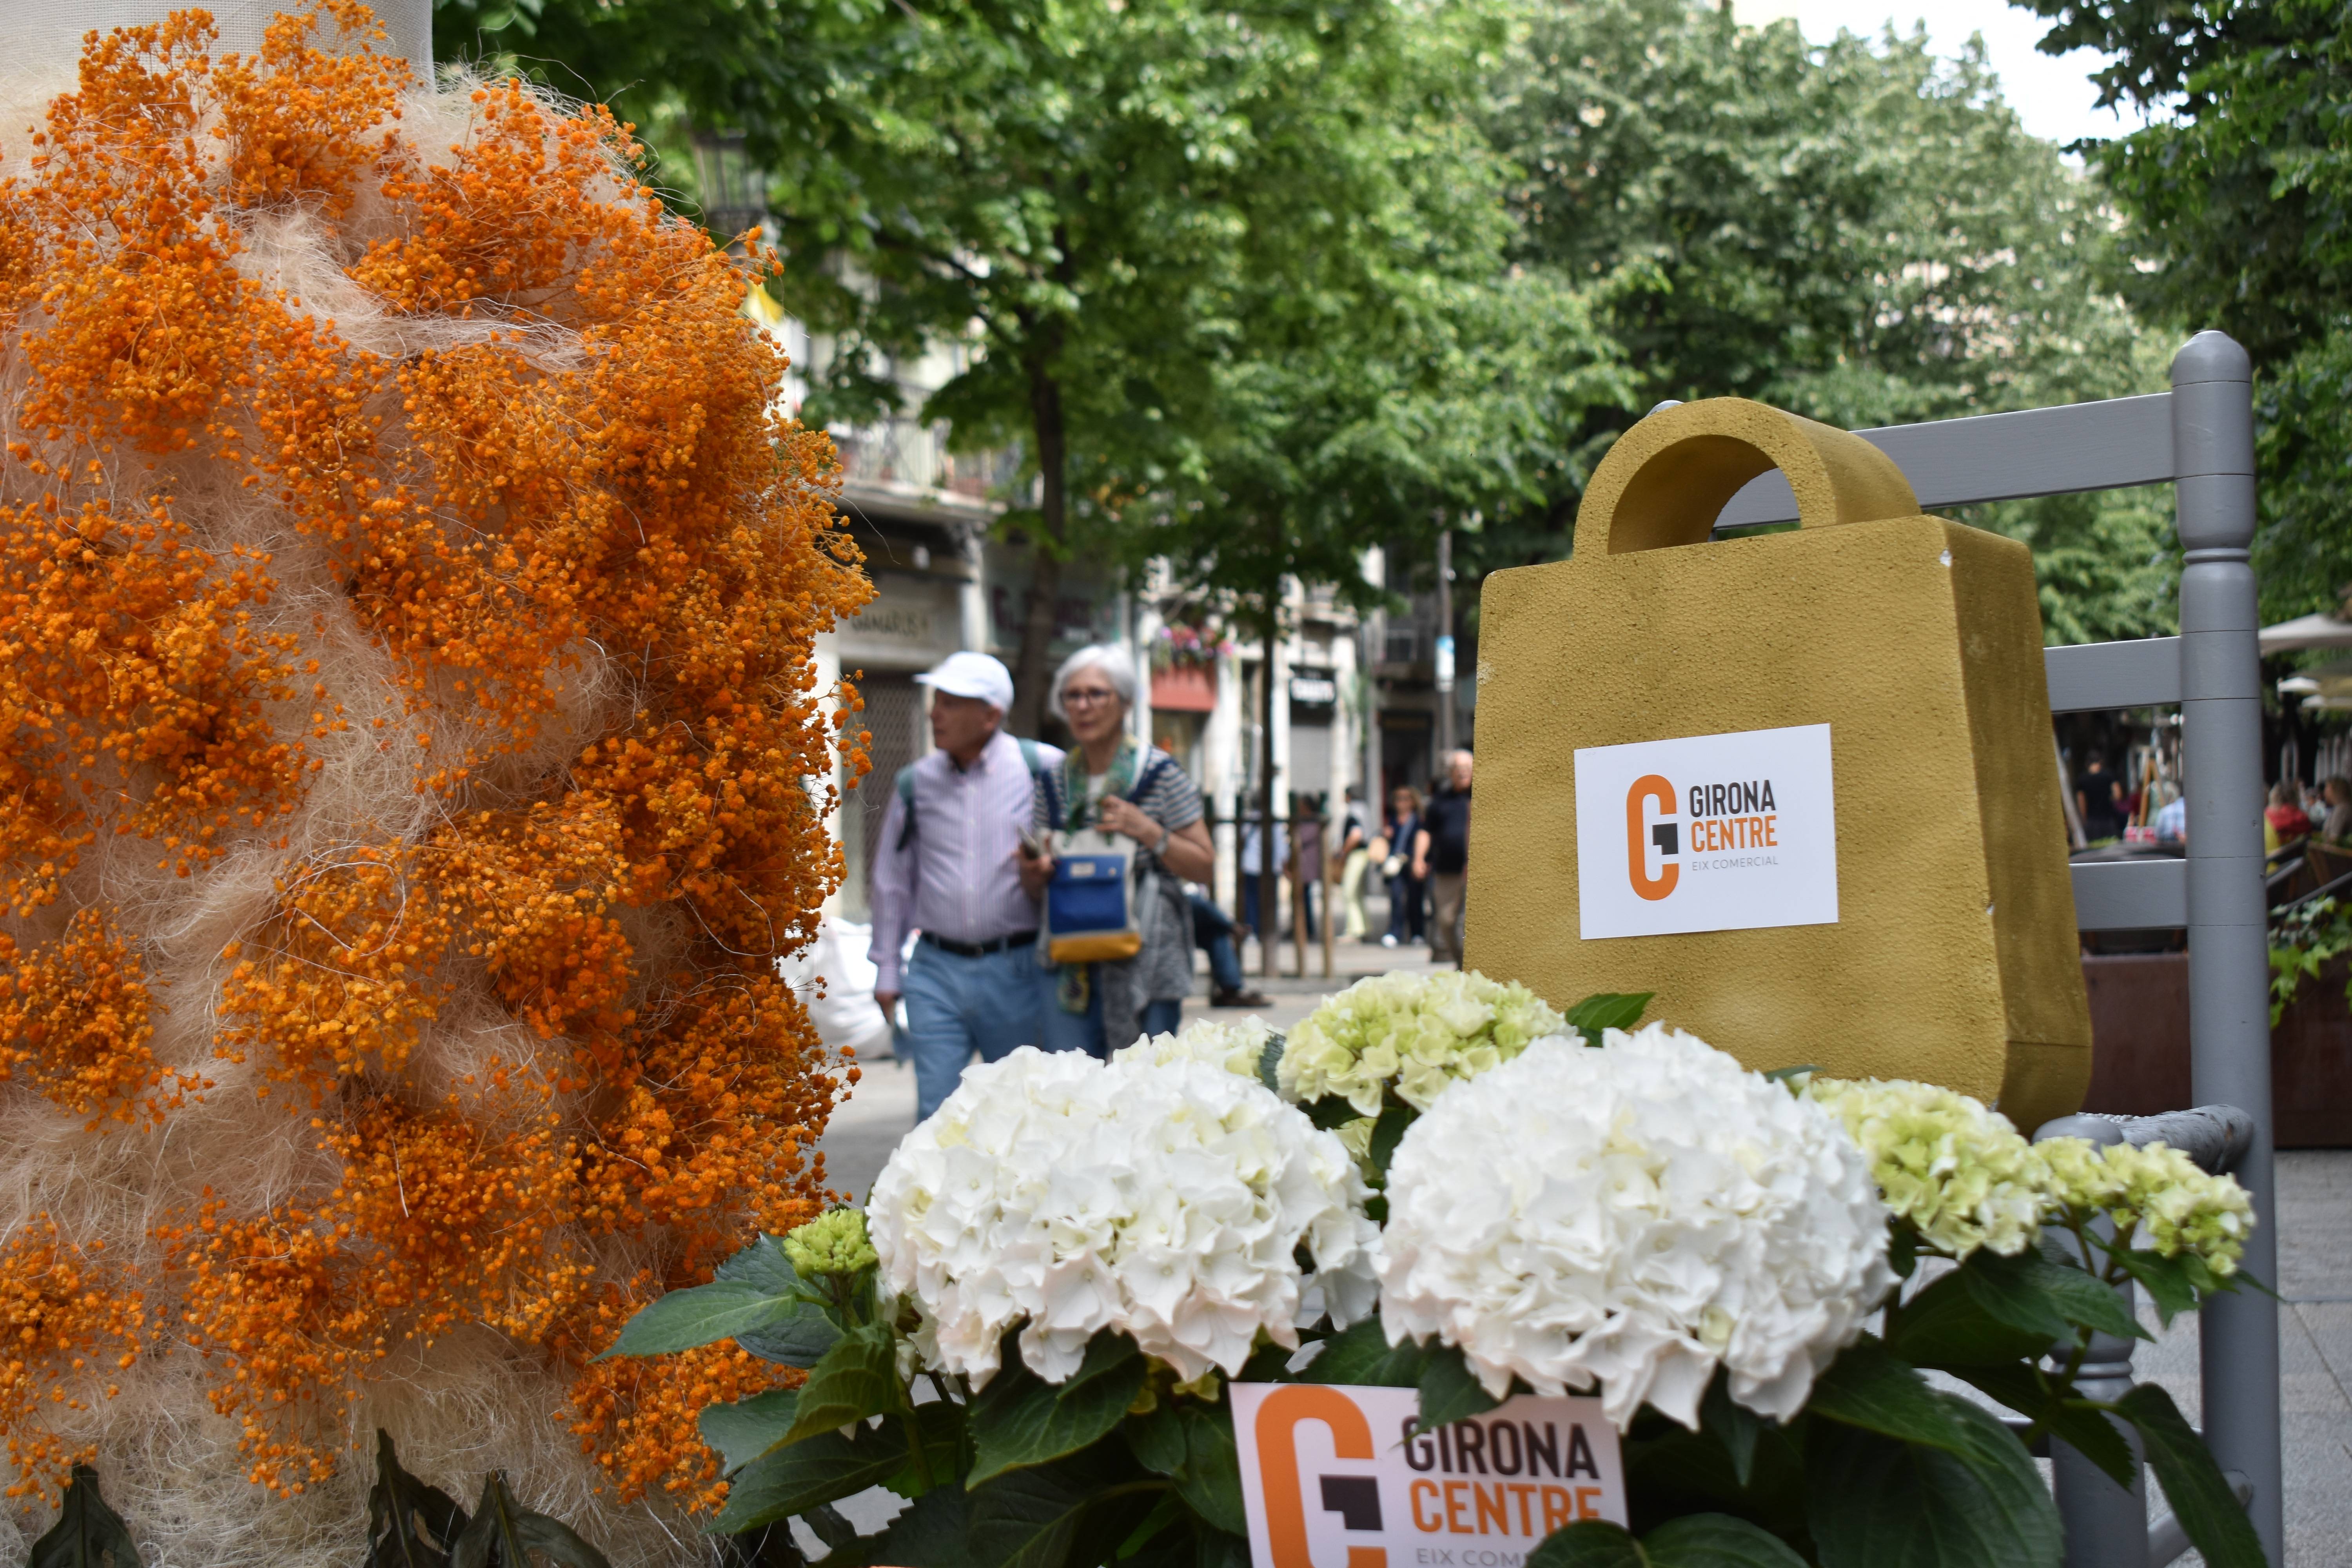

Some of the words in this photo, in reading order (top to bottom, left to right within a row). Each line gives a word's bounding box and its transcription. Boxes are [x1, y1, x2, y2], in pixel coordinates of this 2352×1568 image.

[1689, 779, 1776, 817] GIRONA
[1691, 815, 1777, 852] CENTRE
[1692, 861, 1709, 871] EIX
[1712, 856, 1778, 869] COMERCIAL
[1402, 1415, 1600, 1479] GIRONA
[1409, 1477, 1602, 1537] CENTRE
[1416, 1548, 1455, 1566] EIX
[1462, 1550, 1526, 1567] COM
